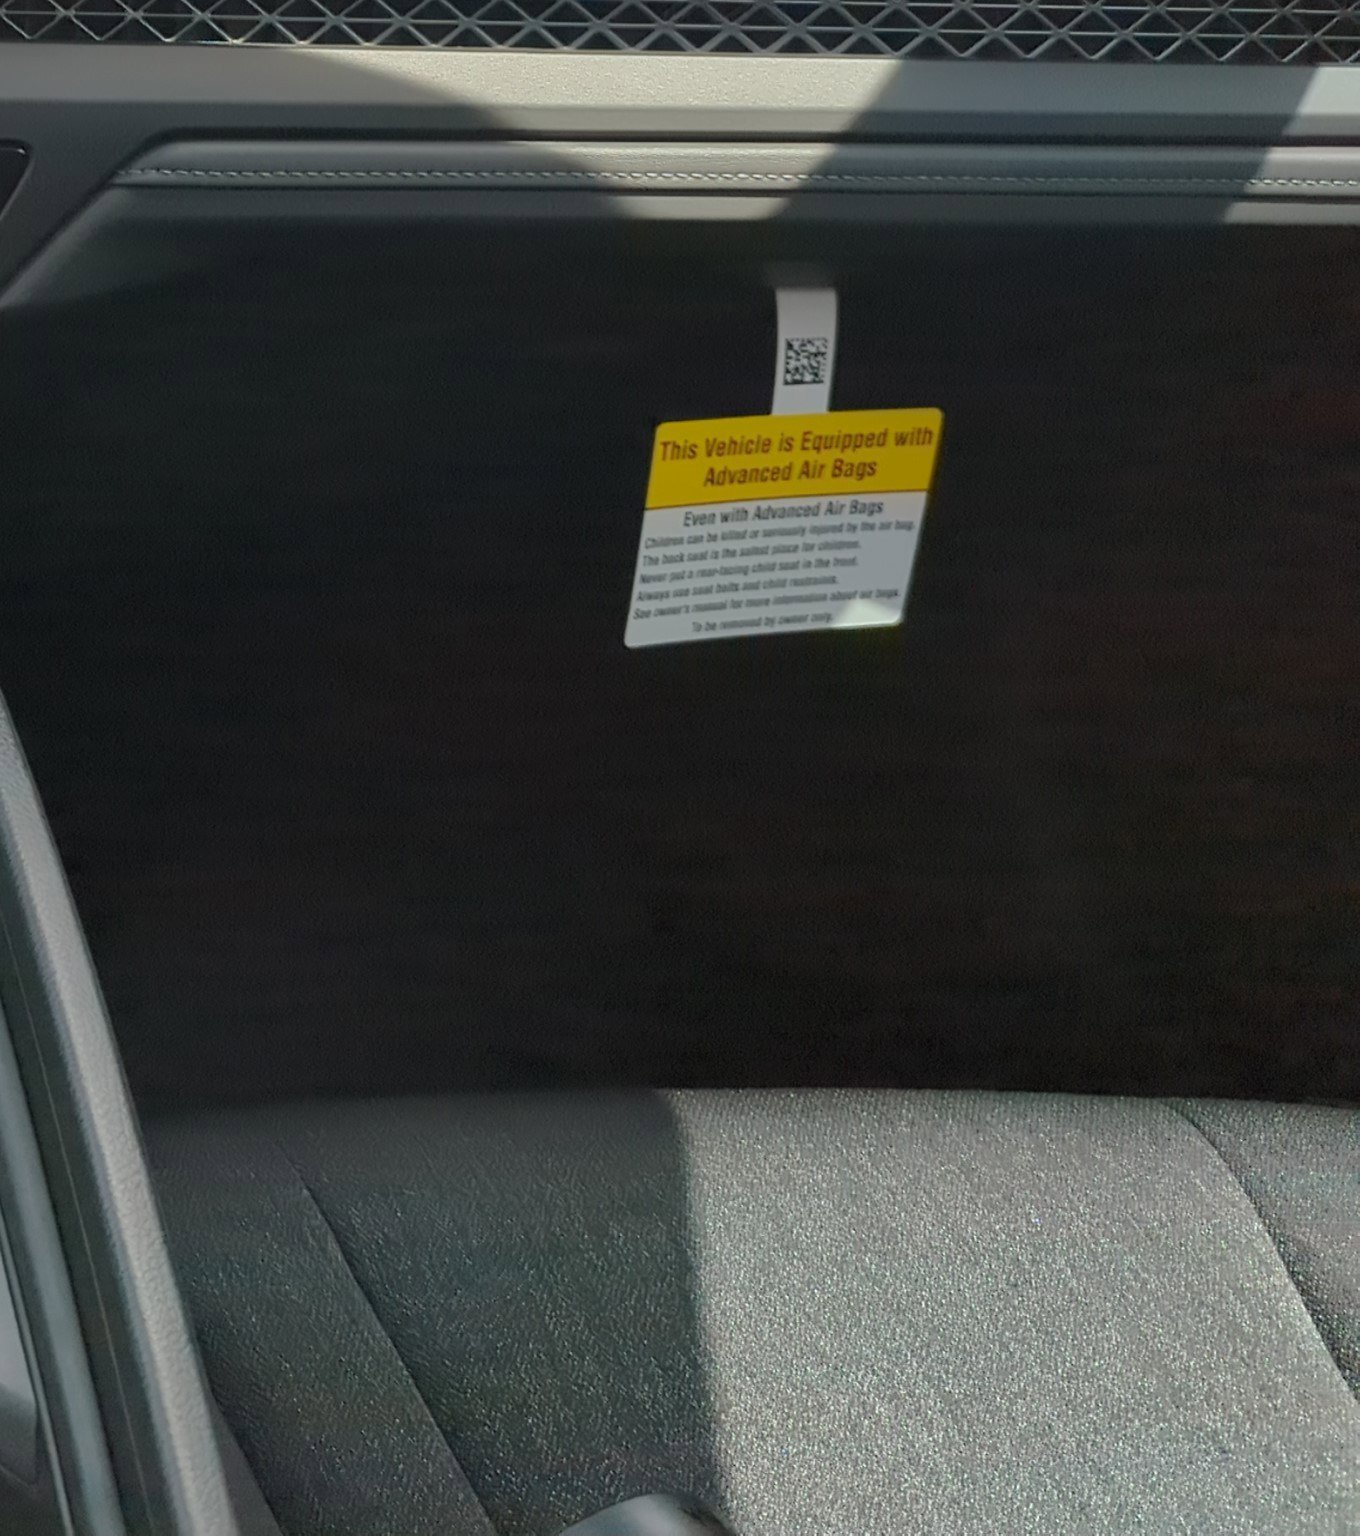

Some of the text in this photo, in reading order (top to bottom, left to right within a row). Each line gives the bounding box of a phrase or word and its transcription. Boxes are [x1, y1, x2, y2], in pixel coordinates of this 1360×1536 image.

[659, 426, 934, 462] This Vehicle is Equipped with
[704, 458, 878, 488] Advanced Air Bags
[682, 499, 885, 527] Even with Advanced Air Bags
